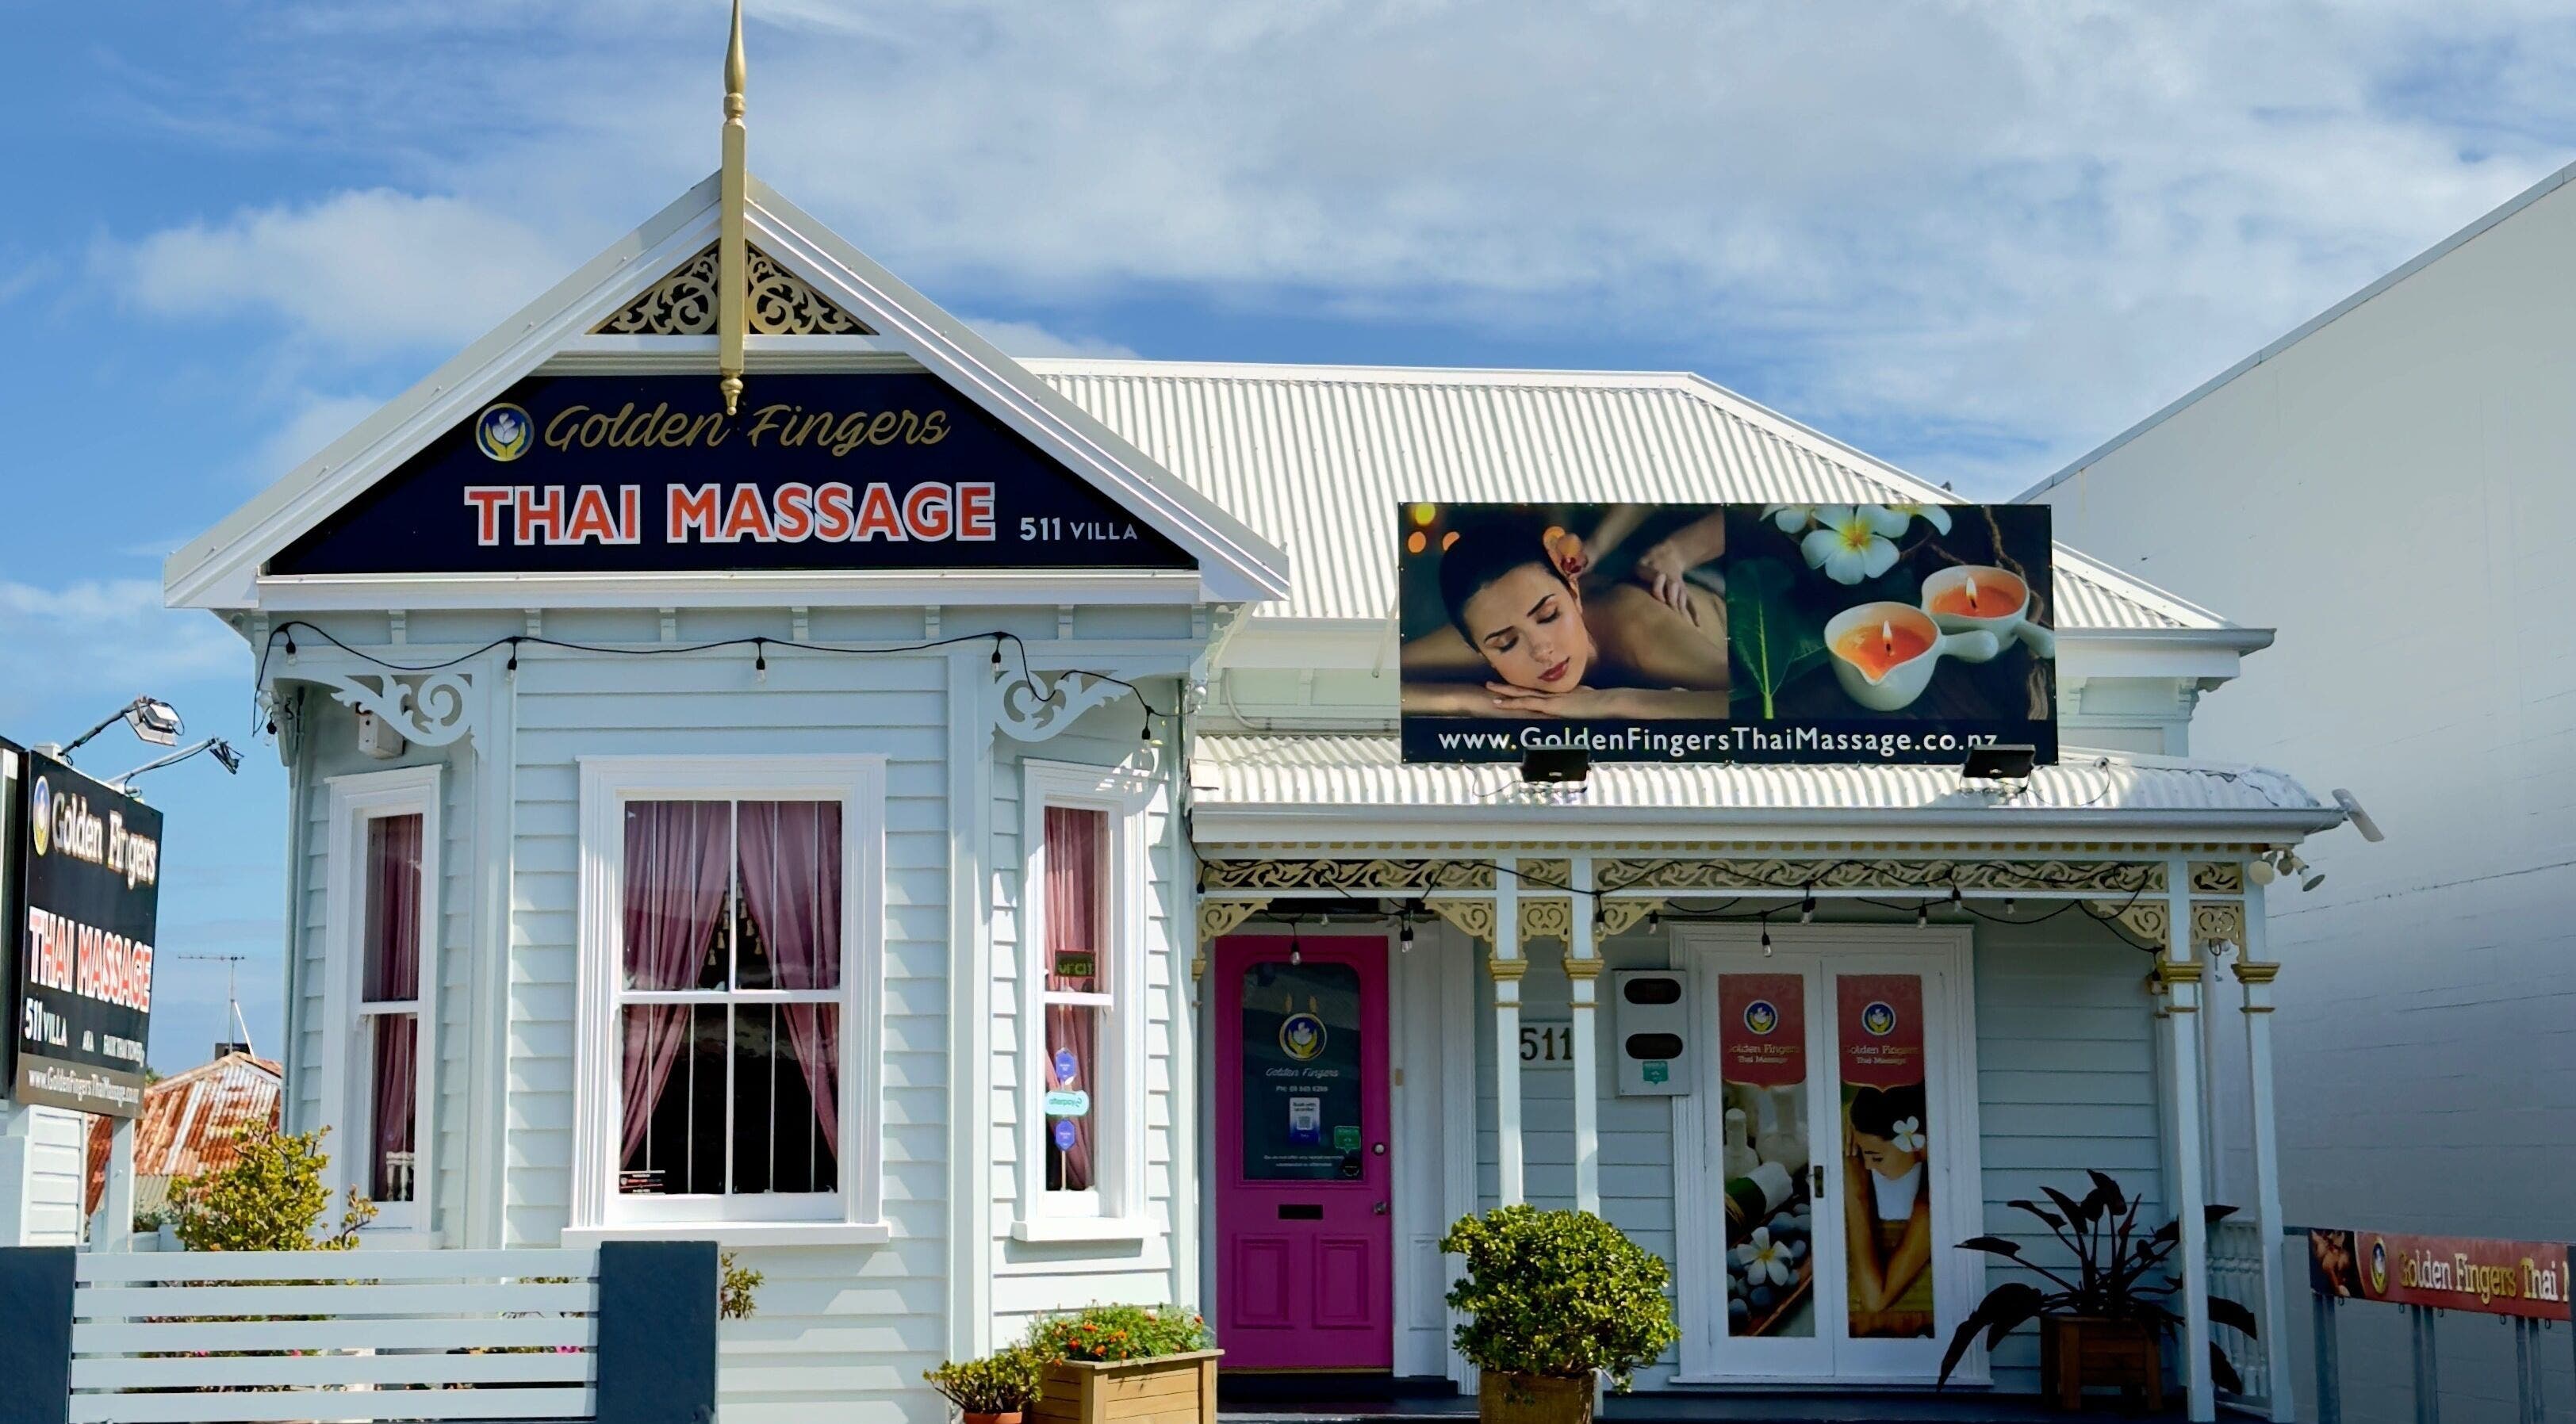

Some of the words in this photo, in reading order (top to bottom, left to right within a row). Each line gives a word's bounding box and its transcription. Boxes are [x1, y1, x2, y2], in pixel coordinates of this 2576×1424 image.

[545, 402, 729, 453] Golden
[747, 404, 951, 457] Fingers
[465, 484, 641, 545] THAI
[666, 482, 996, 545] MASSAGE
[1019, 517, 1062, 542] 511
[1070, 521, 1138, 541] VILLA
[1437, 727, 1998, 758] www.GoldenFingersThaiMassage.co.nz
[52, 791, 103, 864] Golden
[108, 810, 157, 890] Fingers
[29, 906, 75, 993] THAI
[77, 924, 153, 1013] MASSAGE
[25, 997, 43, 1041] 511
[43, 1012, 67, 1047] VILLA
[1520, 1028, 1573, 1061] 511
[1729, 1044, 1761, 1054] olden
[1847, 1045, 1879, 1054] olden
[2399, 1248, 2452, 1292] Golden
[2455, 1253, 2517, 1304] Fingers
[2520, 1257, 2558, 1302] Thai
